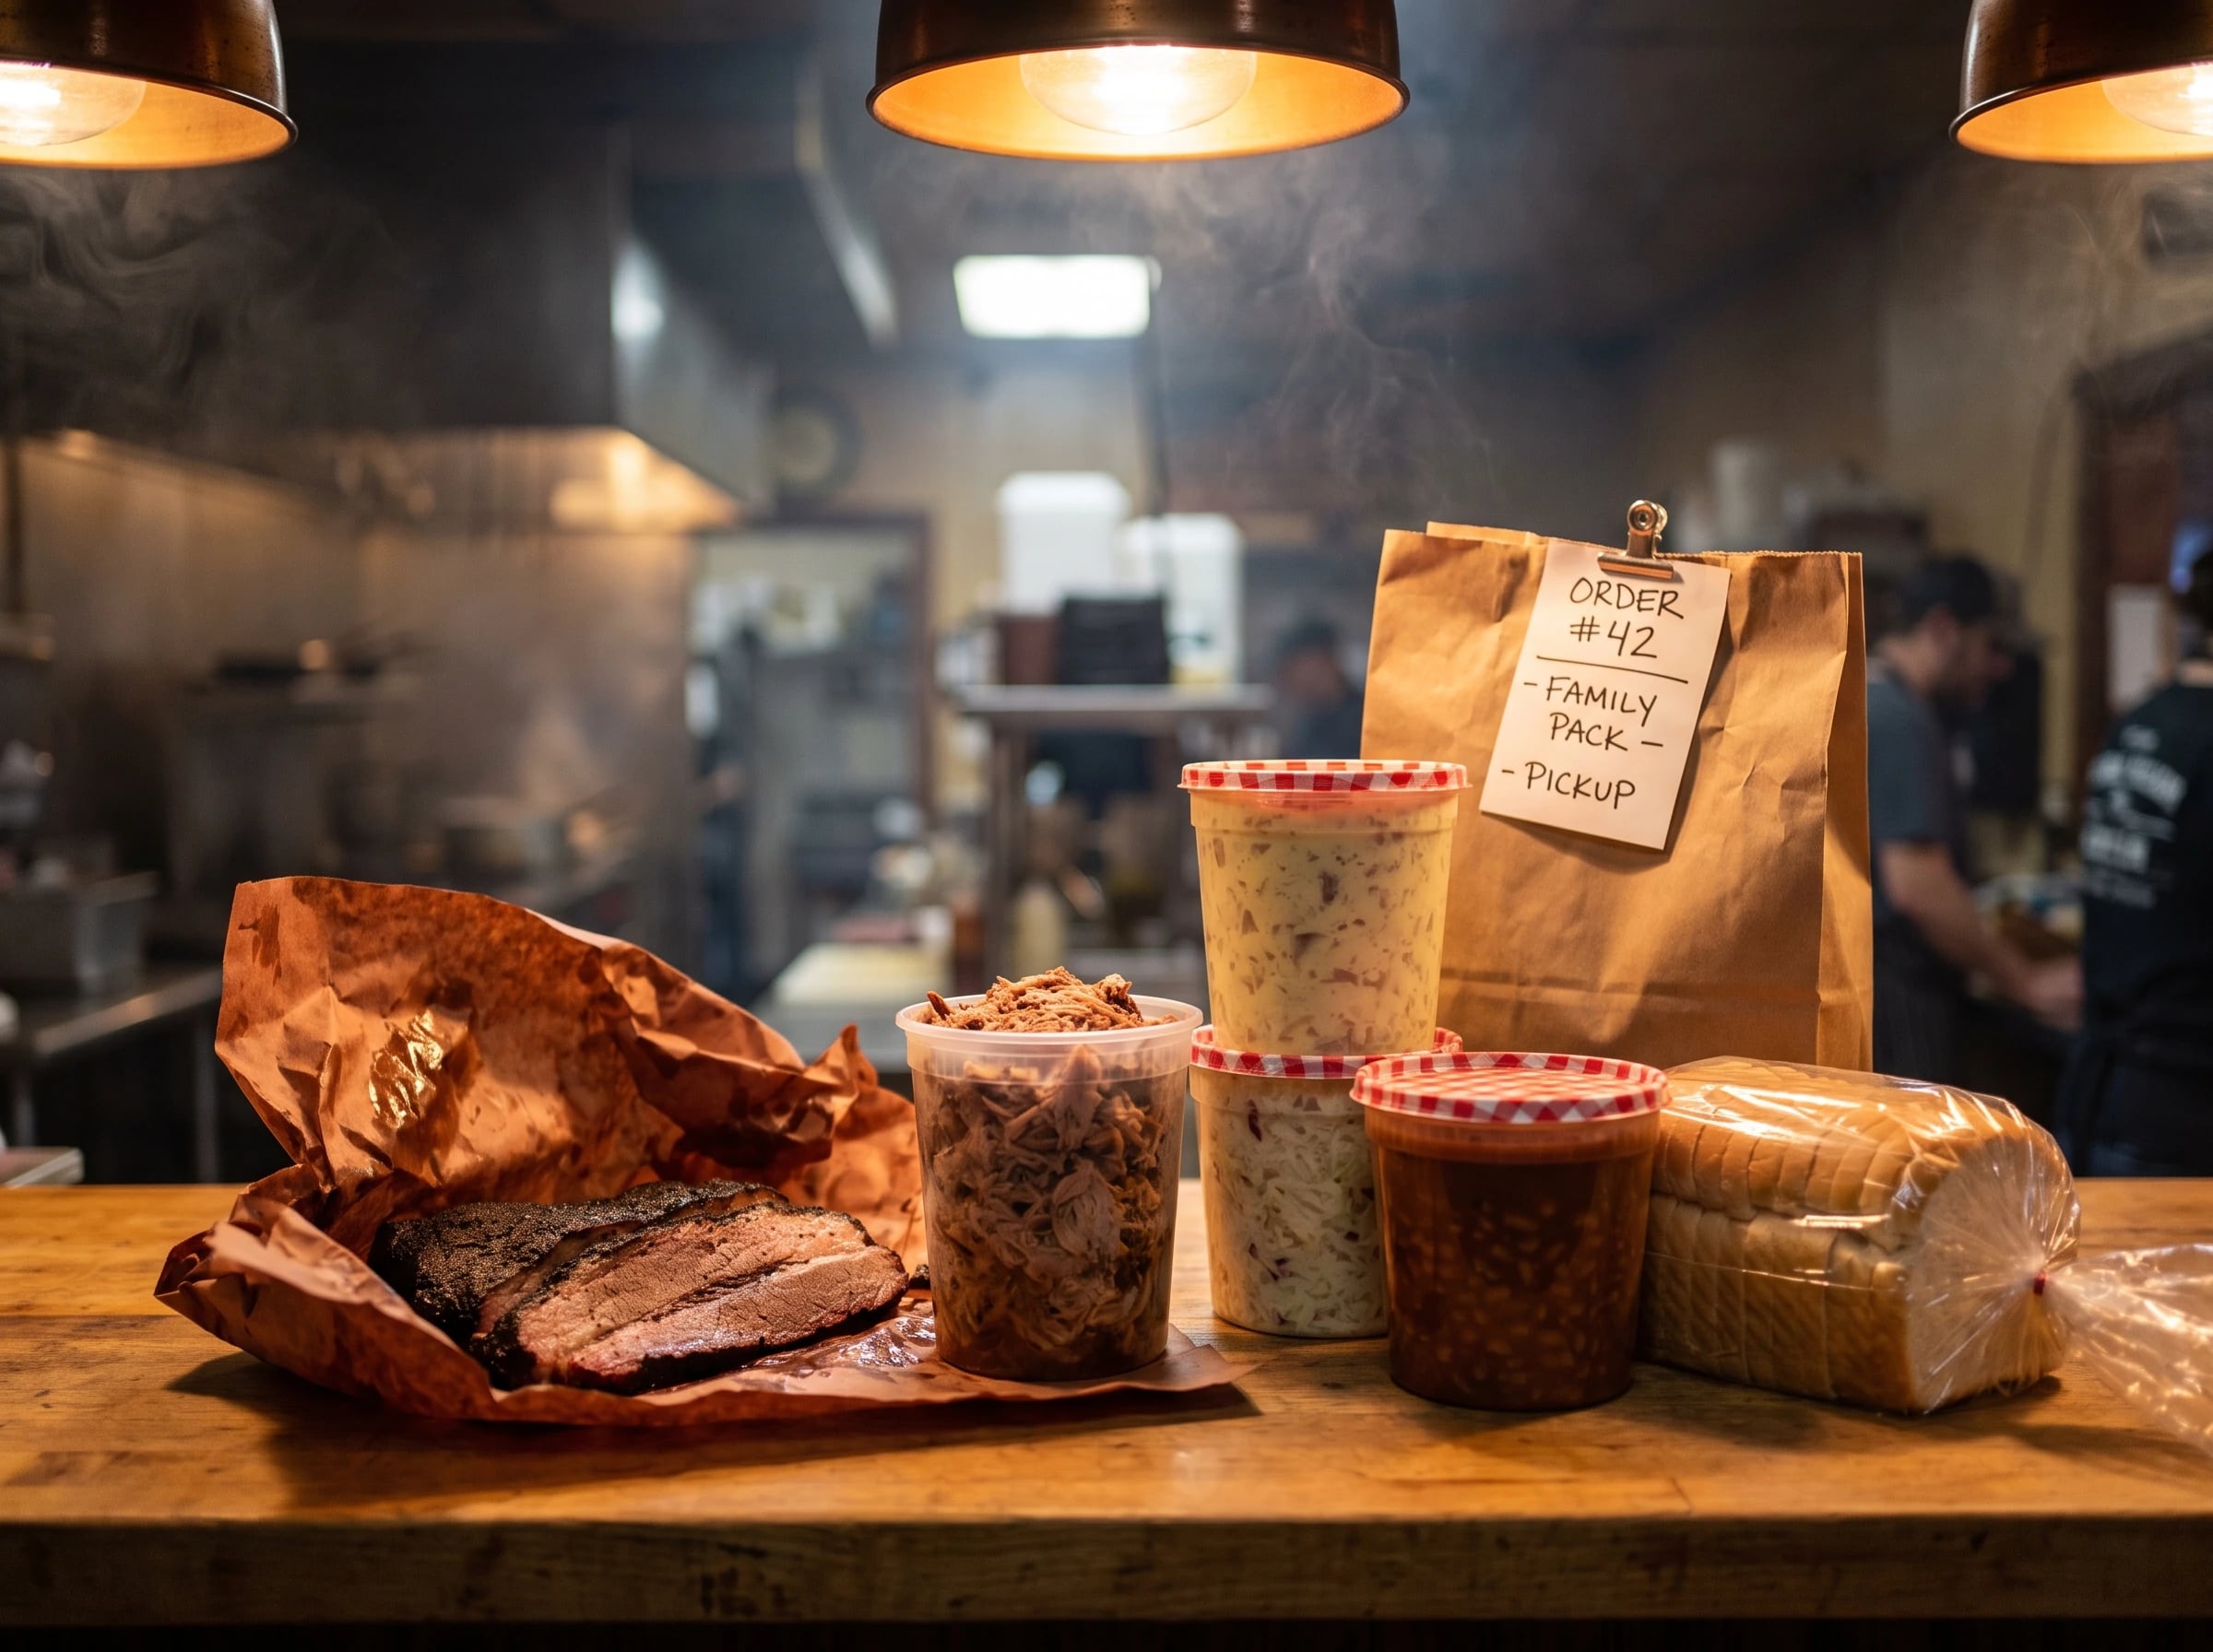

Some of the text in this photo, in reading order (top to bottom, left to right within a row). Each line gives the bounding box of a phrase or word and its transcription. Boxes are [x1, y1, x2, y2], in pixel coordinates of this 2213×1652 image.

[1569, 577, 1684, 620] ORDER
[1569, 616, 1658, 658] #42
[1546, 676, 1657, 727] FAMILY
[1549, 712, 1628, 751] PACK
[1525, 761, 1636, 809] PICKUP
